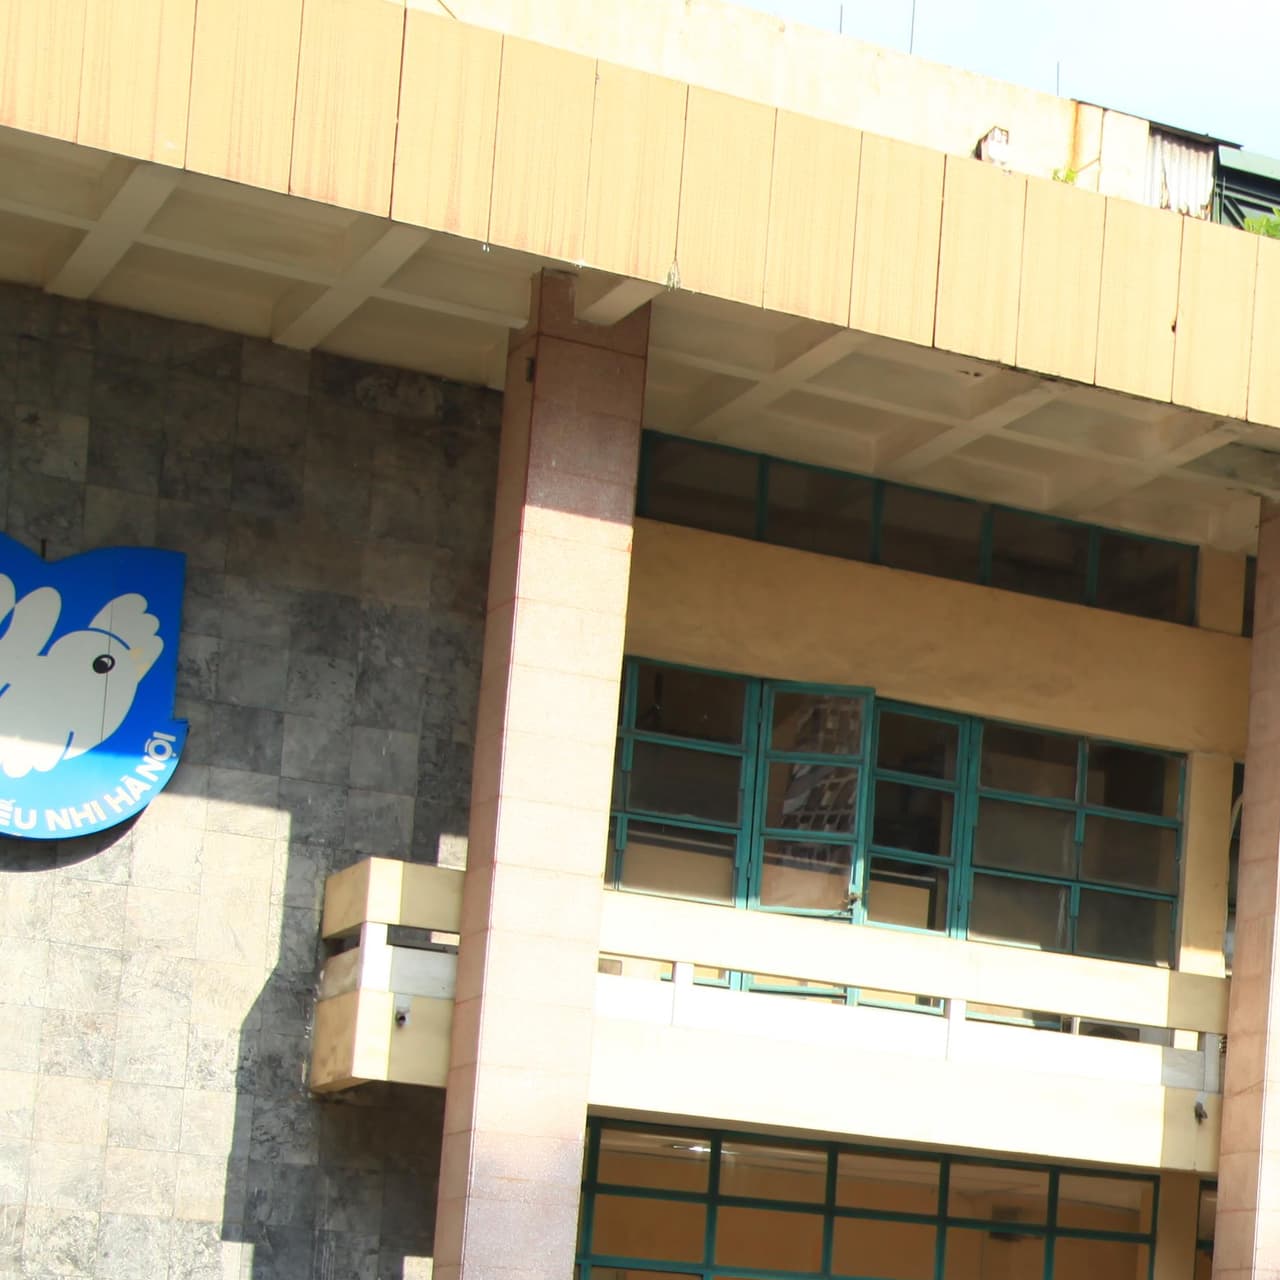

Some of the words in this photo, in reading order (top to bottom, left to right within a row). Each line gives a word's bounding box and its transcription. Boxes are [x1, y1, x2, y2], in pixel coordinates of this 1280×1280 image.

[44, 800, 107, 831] NHI
[103, 775, 153, 814] HÀ
[135, 731, 177, 783] NỘI
